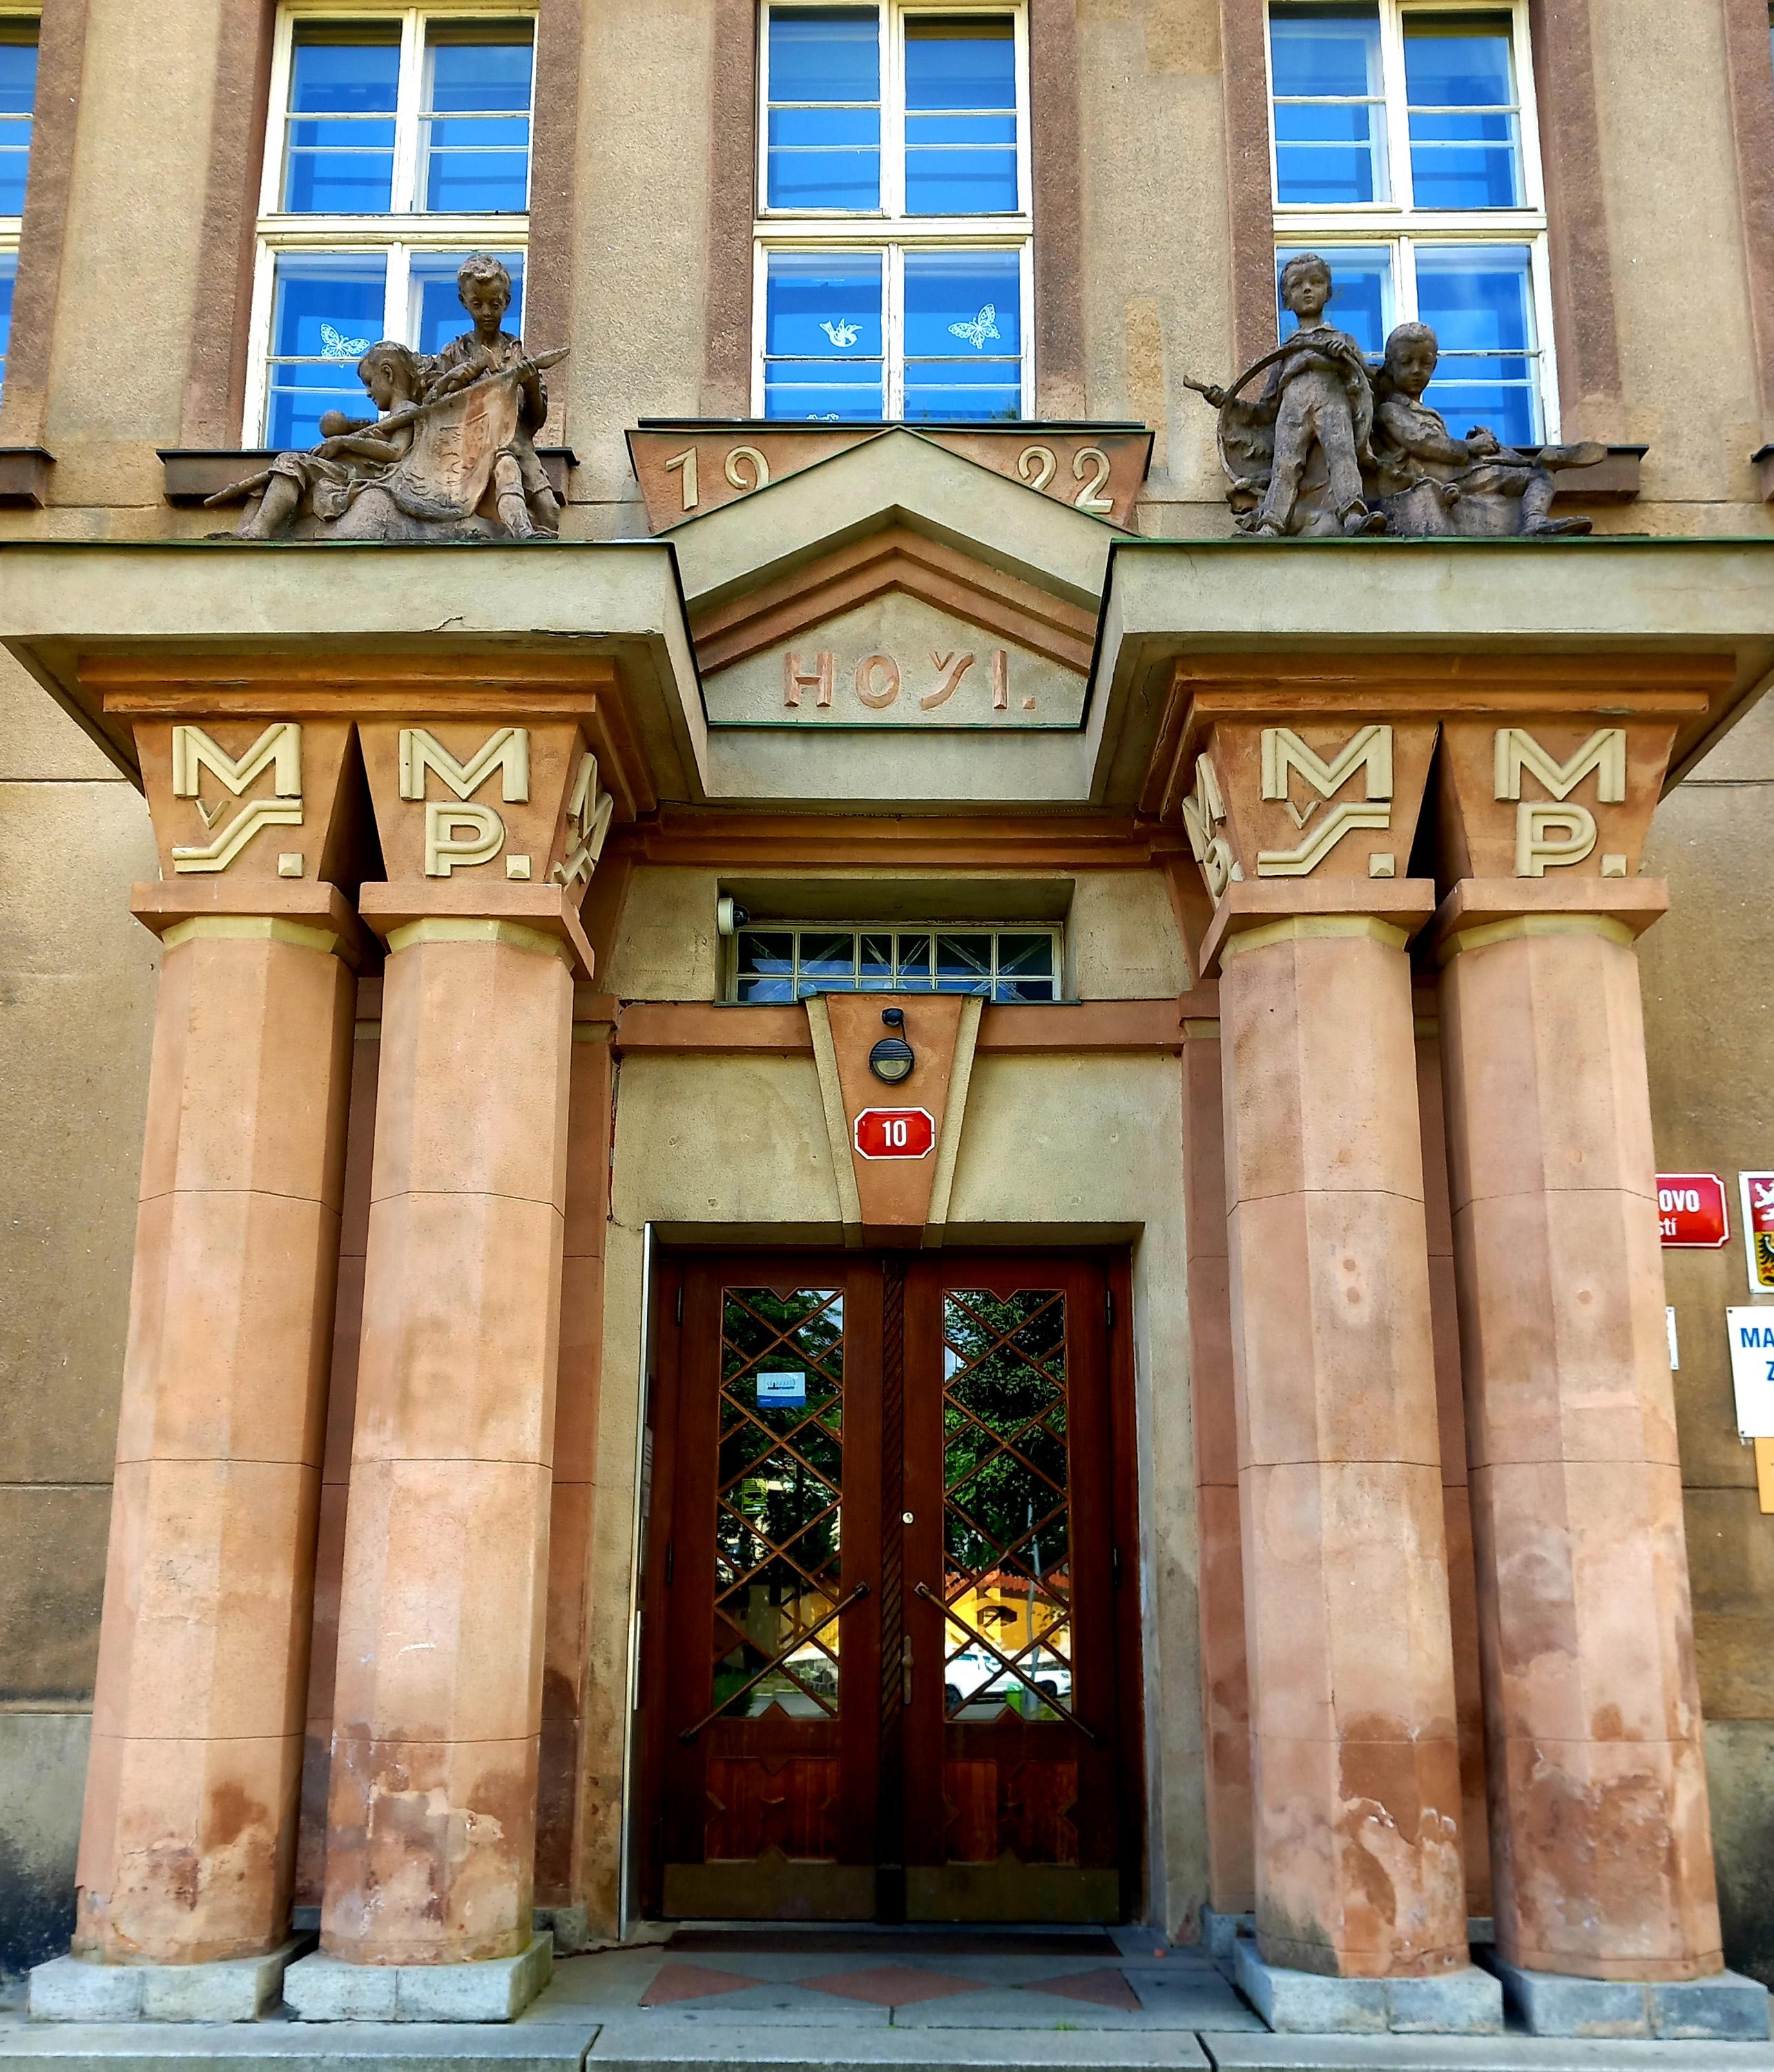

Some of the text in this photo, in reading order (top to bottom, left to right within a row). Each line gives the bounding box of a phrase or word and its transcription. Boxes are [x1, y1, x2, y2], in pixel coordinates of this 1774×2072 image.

[172, 722, 302, 798] M
[398, 727, 530, 803] M
[1261, 725, 1394, 801] M
[1494, 728, 1626, 803] M
[882, 1120, 907, 1147] 10
